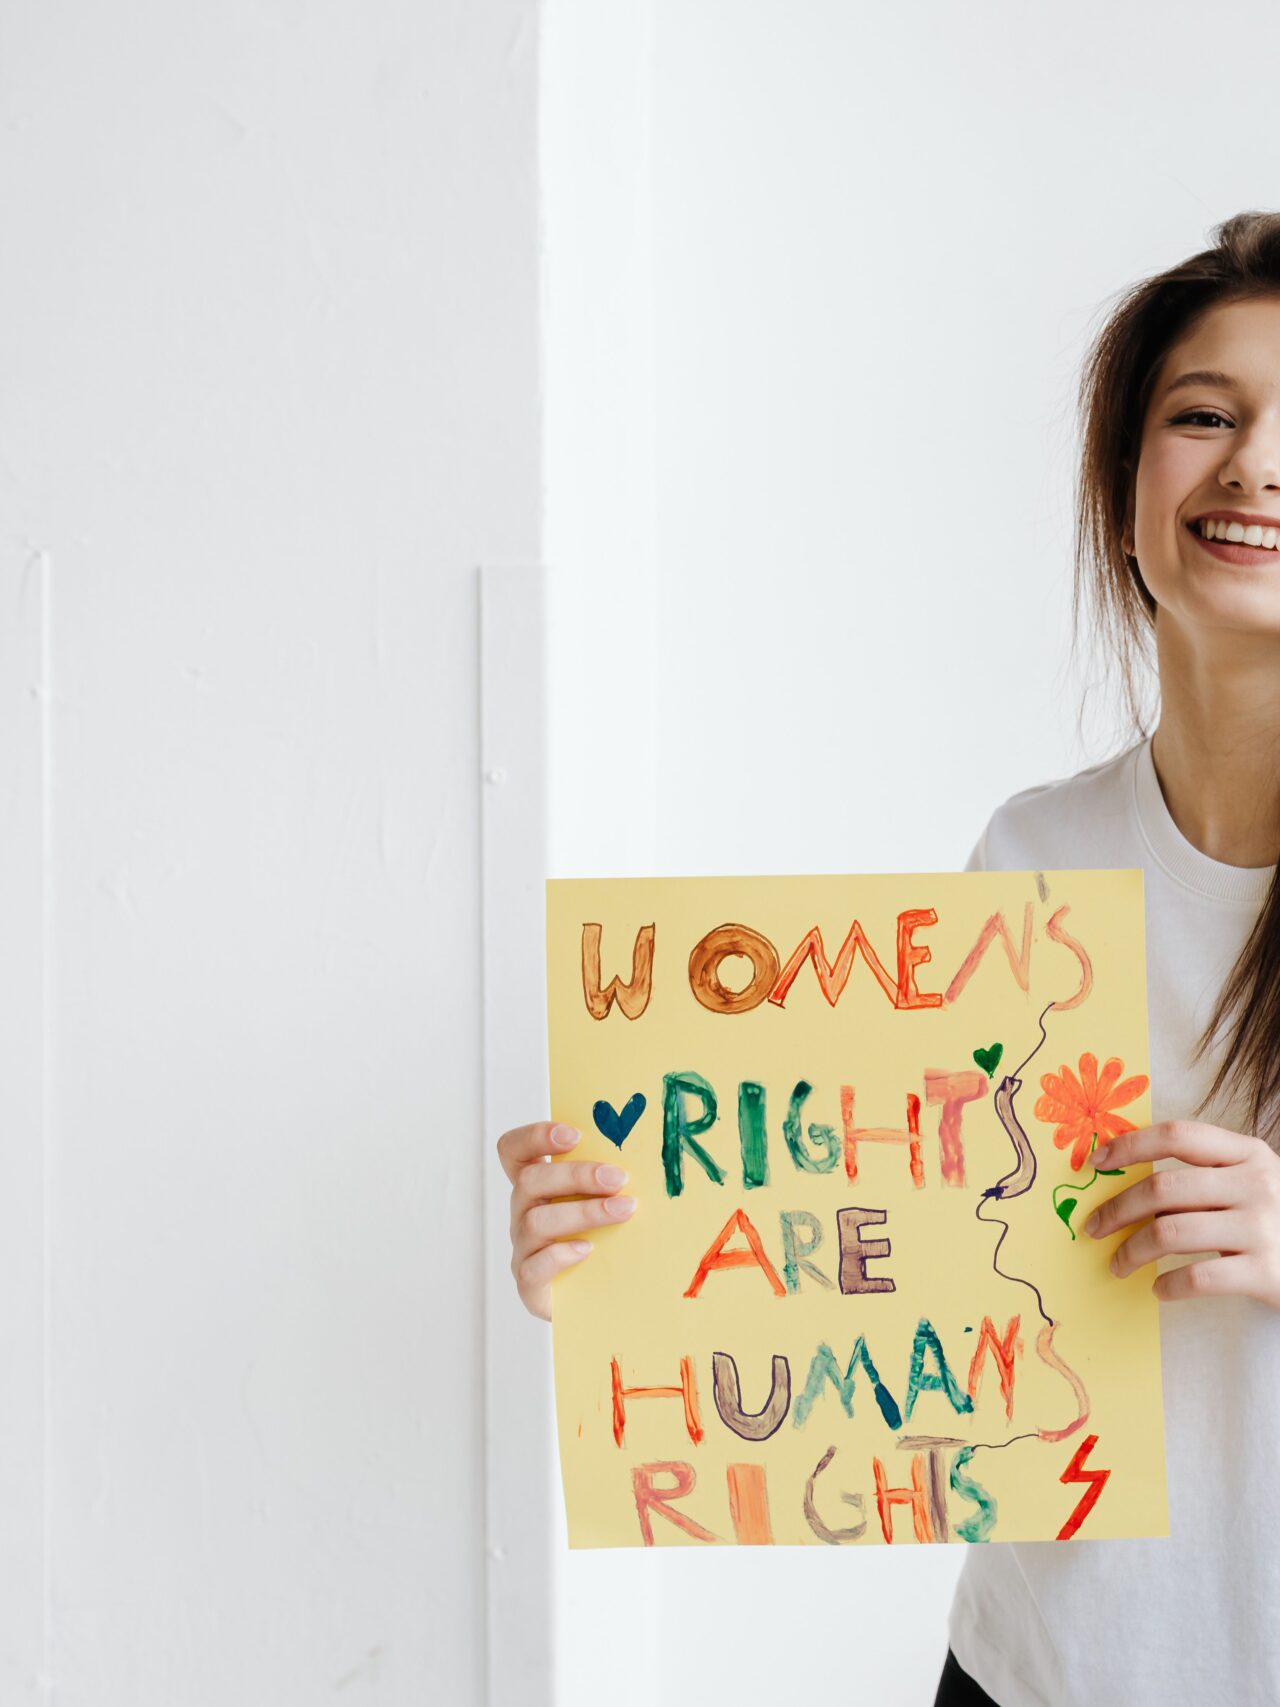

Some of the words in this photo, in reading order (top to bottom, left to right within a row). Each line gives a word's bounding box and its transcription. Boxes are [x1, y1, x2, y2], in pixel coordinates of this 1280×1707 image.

[582, 872, 1093, 1021] WOMEN'S
[661, 1067, 1037, 1200] RIGHTS
[684, 1207, 896, 1298] ARE
[610, 1314, 1090, 1448] HUMANS
[632, 1435, 998, 1548] RIGHTS
